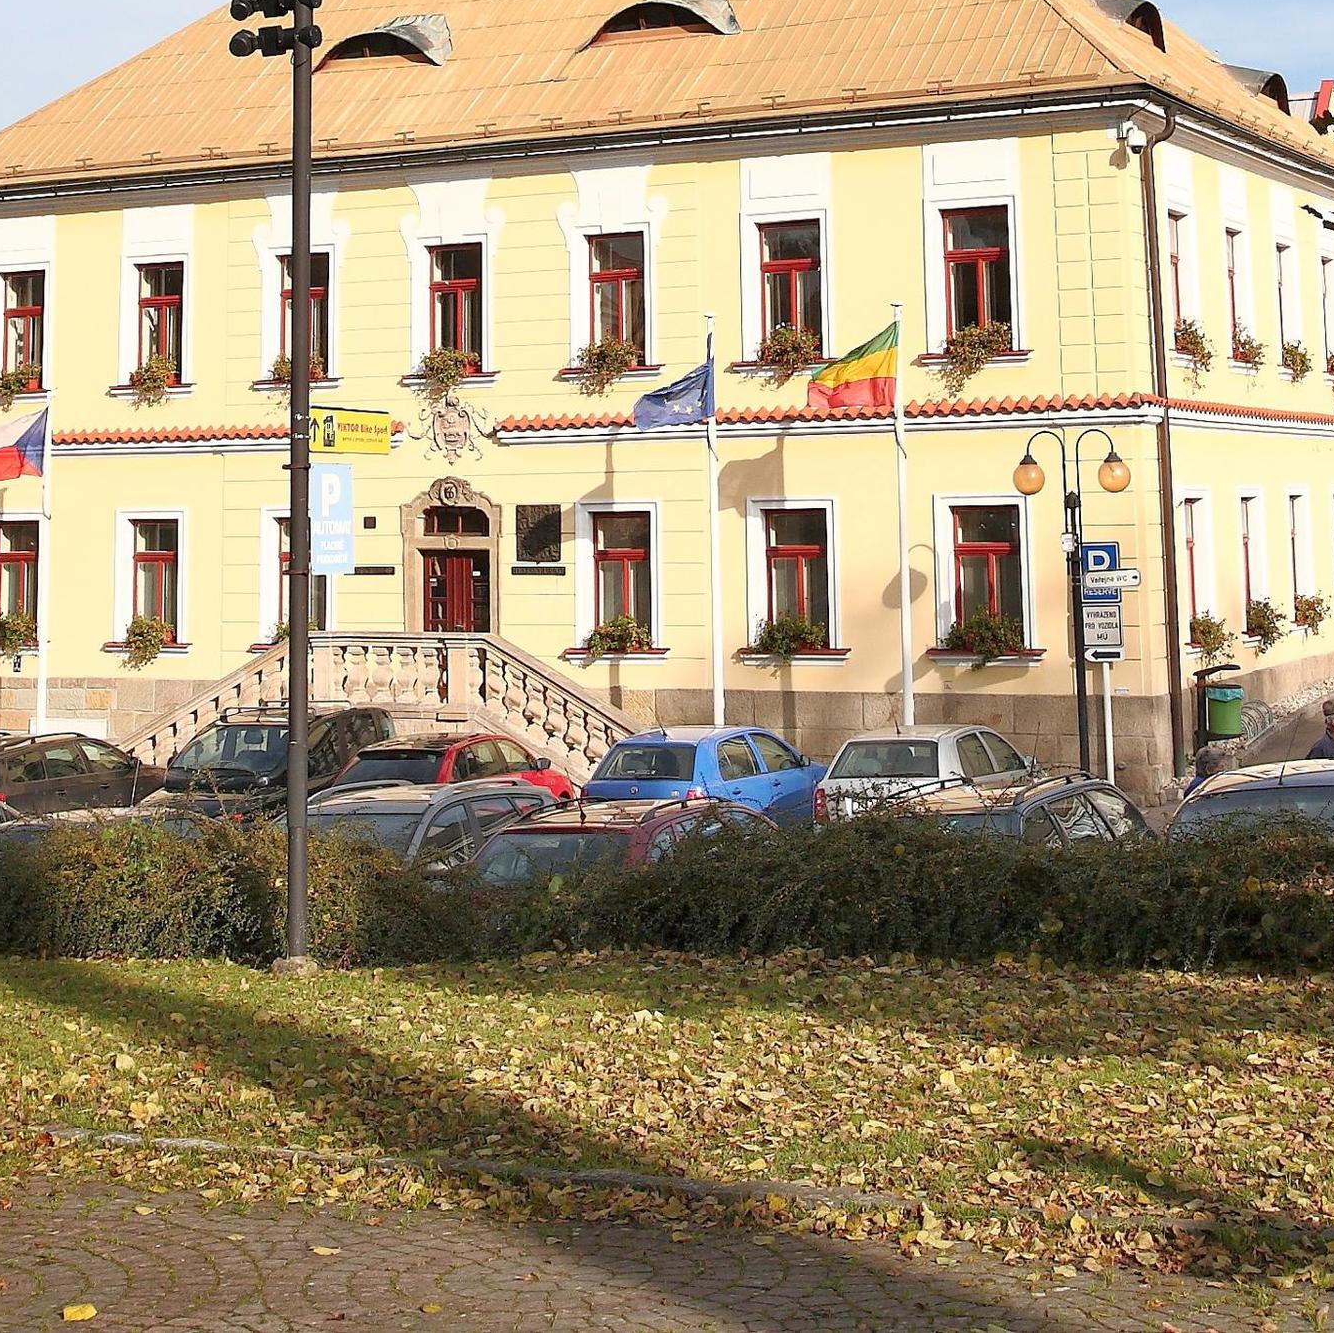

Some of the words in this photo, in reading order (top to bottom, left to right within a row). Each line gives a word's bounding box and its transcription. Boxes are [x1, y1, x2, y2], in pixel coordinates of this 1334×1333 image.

[321, 473, 341, 518] P
[1116, 574, 1128, 582] WC
[1086, 610, 1117, 620] VYHRAZENO
[1085, 622, 1096, 630] PRO
[1098, 621, 1118, 630] VOZIDLA
